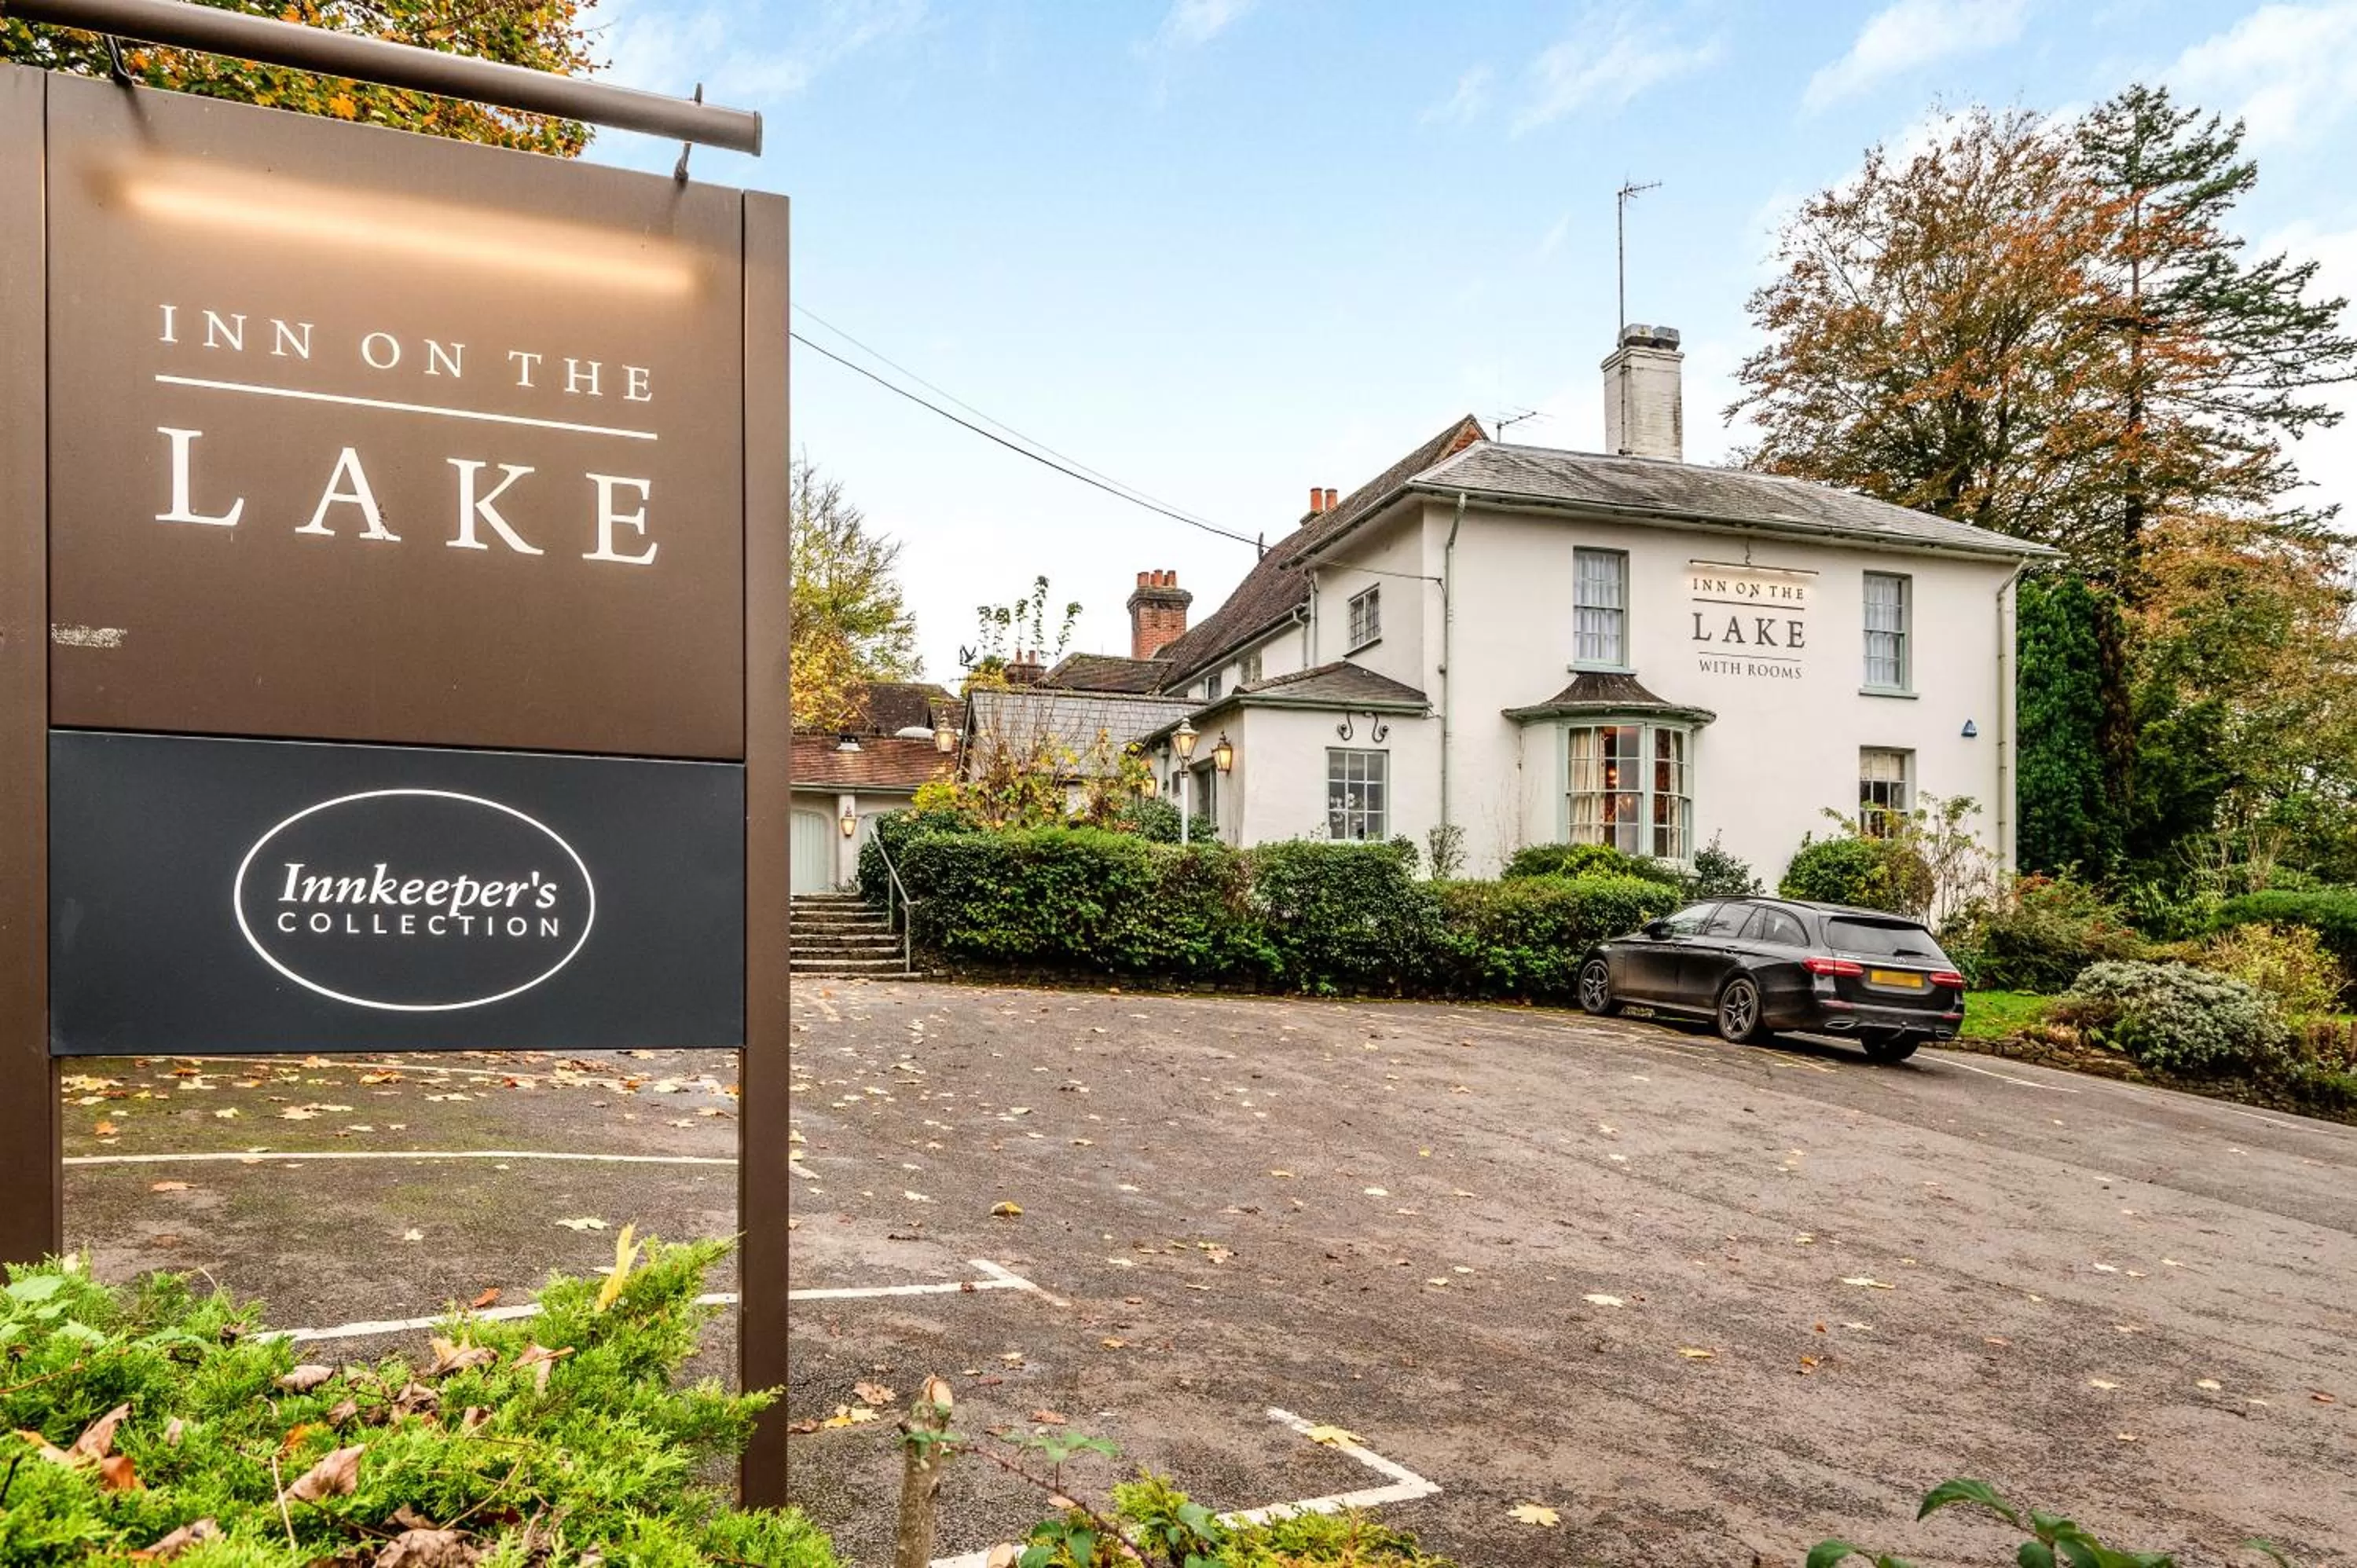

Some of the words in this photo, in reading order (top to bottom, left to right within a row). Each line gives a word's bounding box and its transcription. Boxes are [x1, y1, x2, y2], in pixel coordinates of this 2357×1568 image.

[159, 305, 313, 359] INN
[361, 332, 466, 378] ON
[508, 350, 653, 402] THE
[155, 426, 658, 565] LAKE
[1693, 578, 1726, 592] INN
[1736, 583, 1761, 596] ON
[1769, 586, 1804, 599] THE
[1692, 612, 1806, 648] LAKE
[1699, 660, 1741, 675] WITH
[1748, 664, 1802, 679] ROOMS
[278, 863, 557, 917] Innkeeper's
[277, 913, 559, 937] COLLECTION
